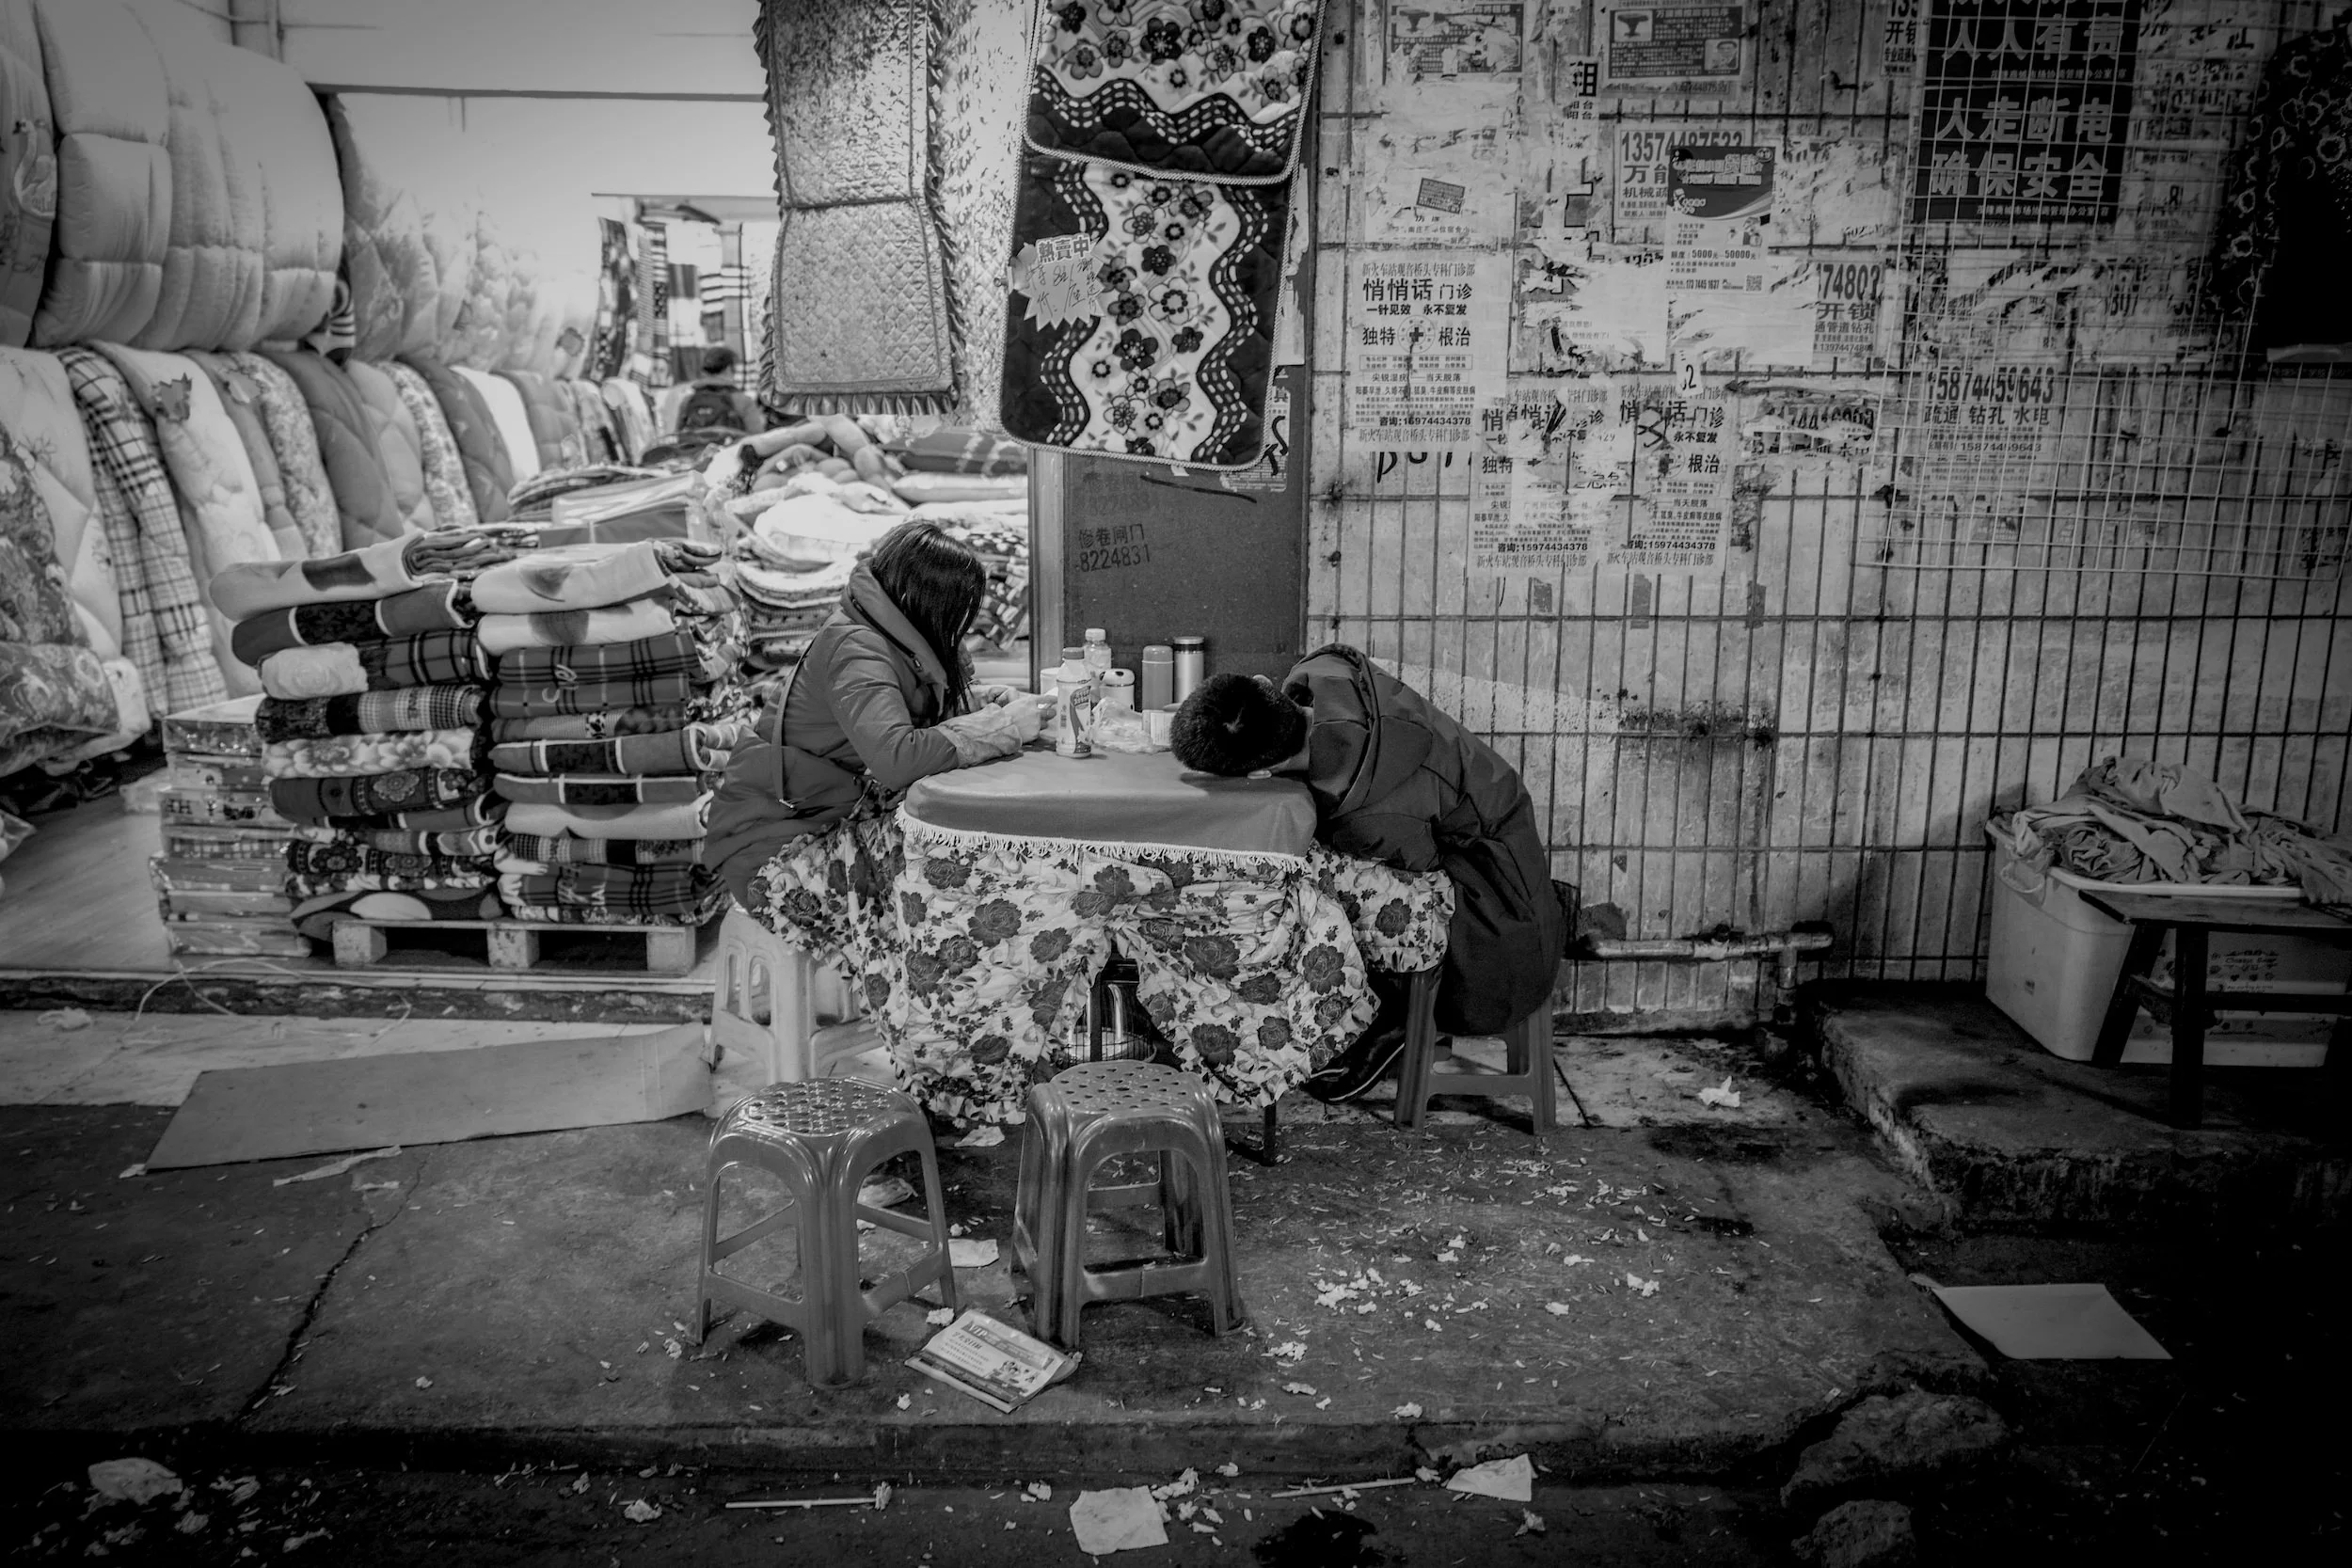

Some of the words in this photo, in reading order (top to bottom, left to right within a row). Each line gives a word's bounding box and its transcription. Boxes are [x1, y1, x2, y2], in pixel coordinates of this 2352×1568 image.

[1941, 12, 2123, 61] 人人有责
[1936, 96, 2112, 143] 人走断电
[1931, 150, 2108, 198] 确保安全
[1039, 236, 1089, 263] 熱賣中
[1362, 277, 1434, 301] 悄悄话
[1439, 282, 1472, 300] 门诊
[1366, 304, 1411, 316] 一针见效
[1422, 304, 1468, 316] 永不复发
[1817, 302, 1877, 321] 开锁
[1362, 325, 1397, 346] 独特
[1438, 326, 1471, 347] 根治
[1927, 365, 2055, 404] 15874459643
[1924, 405, 1960, 424] 疏通
[1968, 405, 2006, 425] 钻孔
[2013, 405, 2050, 426] 水电
[1688, 453, 1721, 474] 根治
[1079, 544, 1151, 573] 8224831
